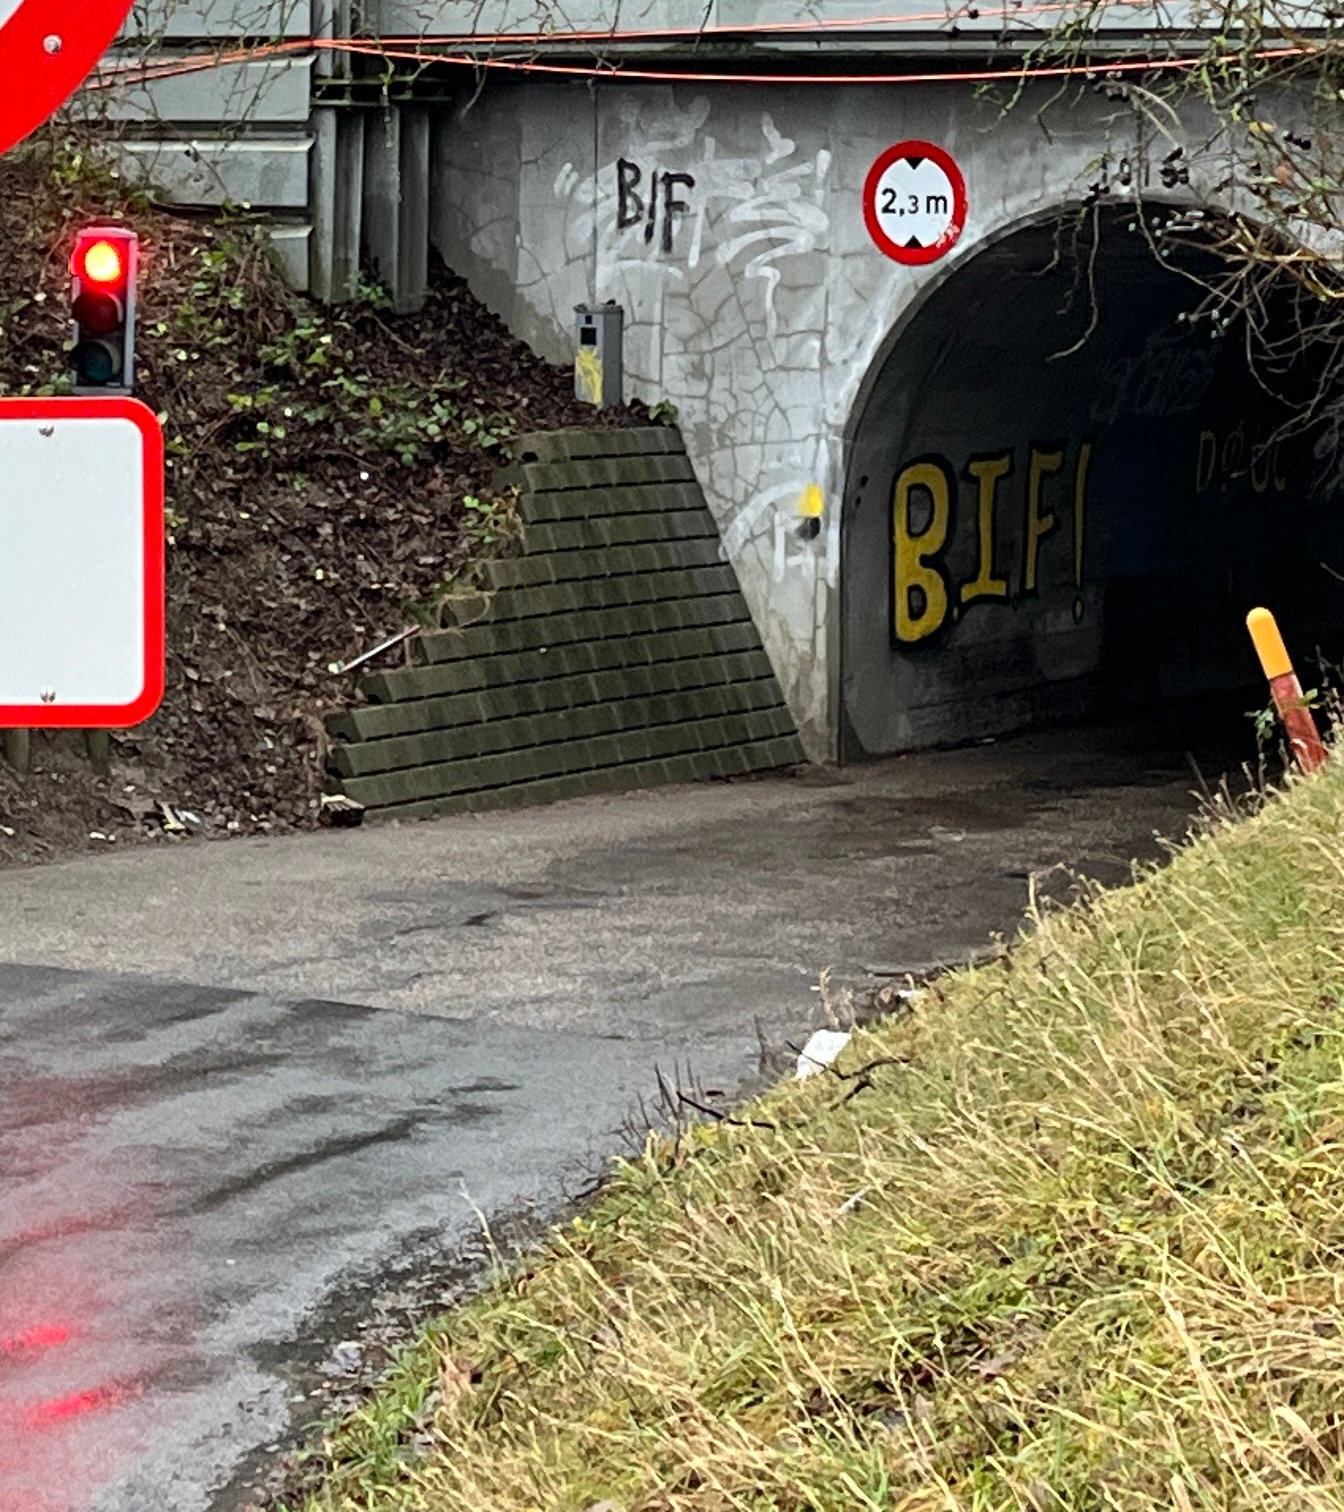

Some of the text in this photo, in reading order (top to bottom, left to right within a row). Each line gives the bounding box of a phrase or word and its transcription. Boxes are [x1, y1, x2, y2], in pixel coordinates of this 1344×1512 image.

[617, 157, 695, 254] BIF
[881, 187, 948, 217] 2,3 m
